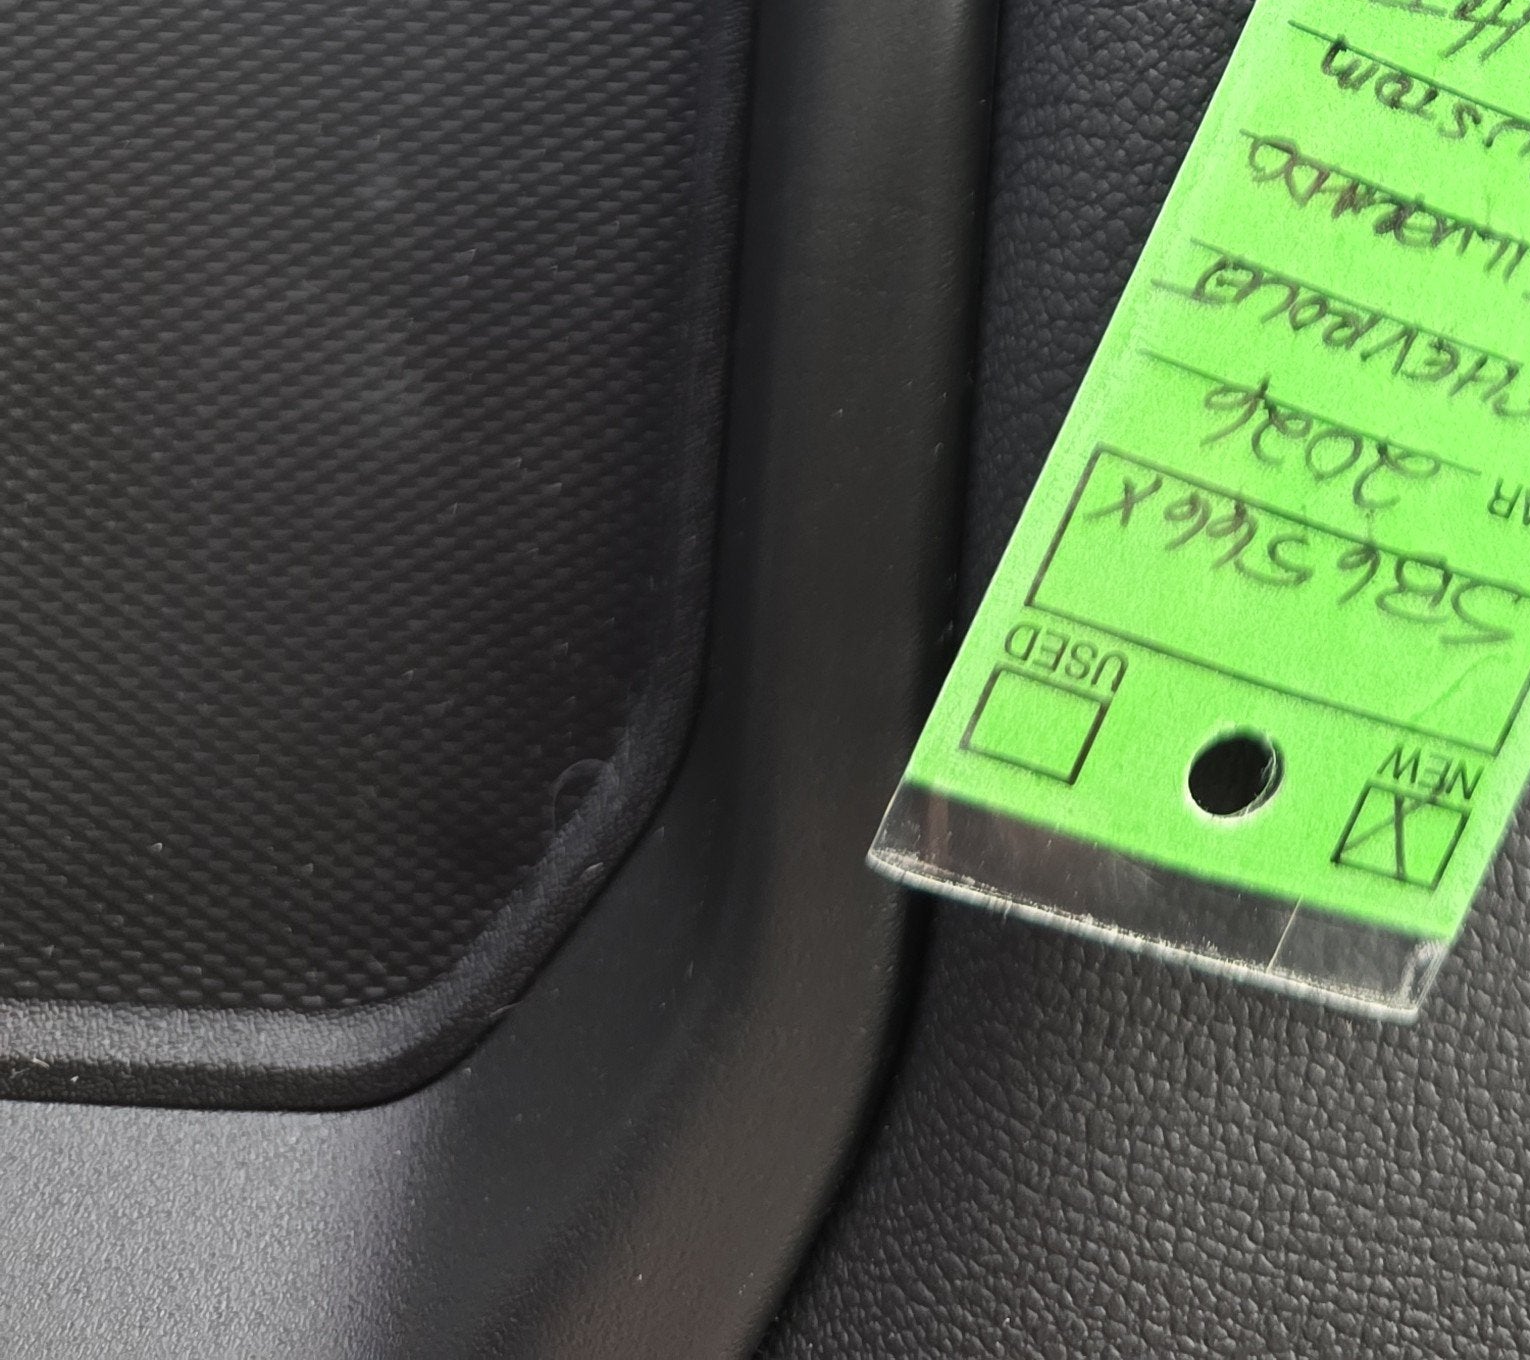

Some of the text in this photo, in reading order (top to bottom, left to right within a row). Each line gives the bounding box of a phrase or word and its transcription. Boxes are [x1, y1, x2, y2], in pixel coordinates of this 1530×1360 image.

[1200, 378, 1439, 507] 2026
[999, 619, 1131, 691] USED
[1377, 742, 1482, 805] NEW
